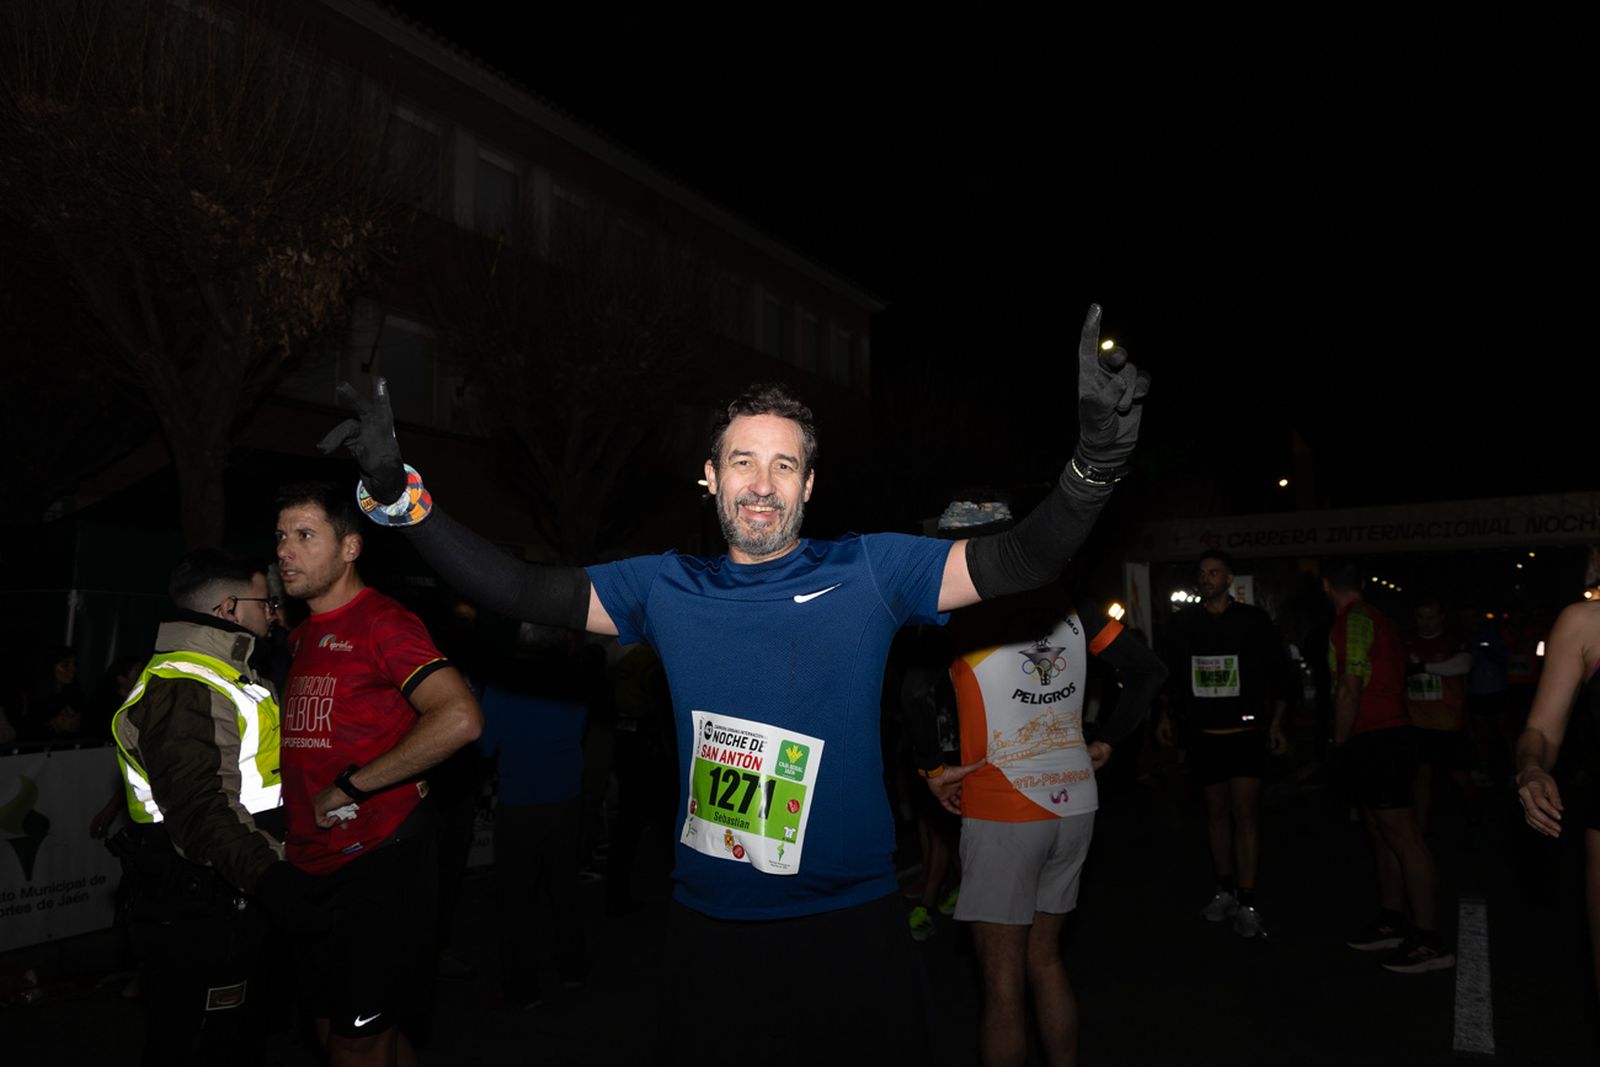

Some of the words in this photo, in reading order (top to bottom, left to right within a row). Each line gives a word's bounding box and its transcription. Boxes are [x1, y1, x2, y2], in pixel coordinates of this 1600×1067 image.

[1227, 527, 1318, 548] CARRERA
[1327, 518, 1516, 543] INTERNACIONAL
[1012, 681, 1077, 705] PELIGROS
[712, 730, 748, 750] NOCHE
[749, 738, 767, 753] DE
[701, 743, 720, 762] SAN
[719, 750, 763, 771] ANTÓN
[708, 766, 777, 820] 1271
[713, 811, 750, 829] Sebastian
[20, 876, 87, 898] Municipal
[89, 874, 107, 886] de
[36, 898, 55, 911] de
[57, 890, 89, 907] Jaén
